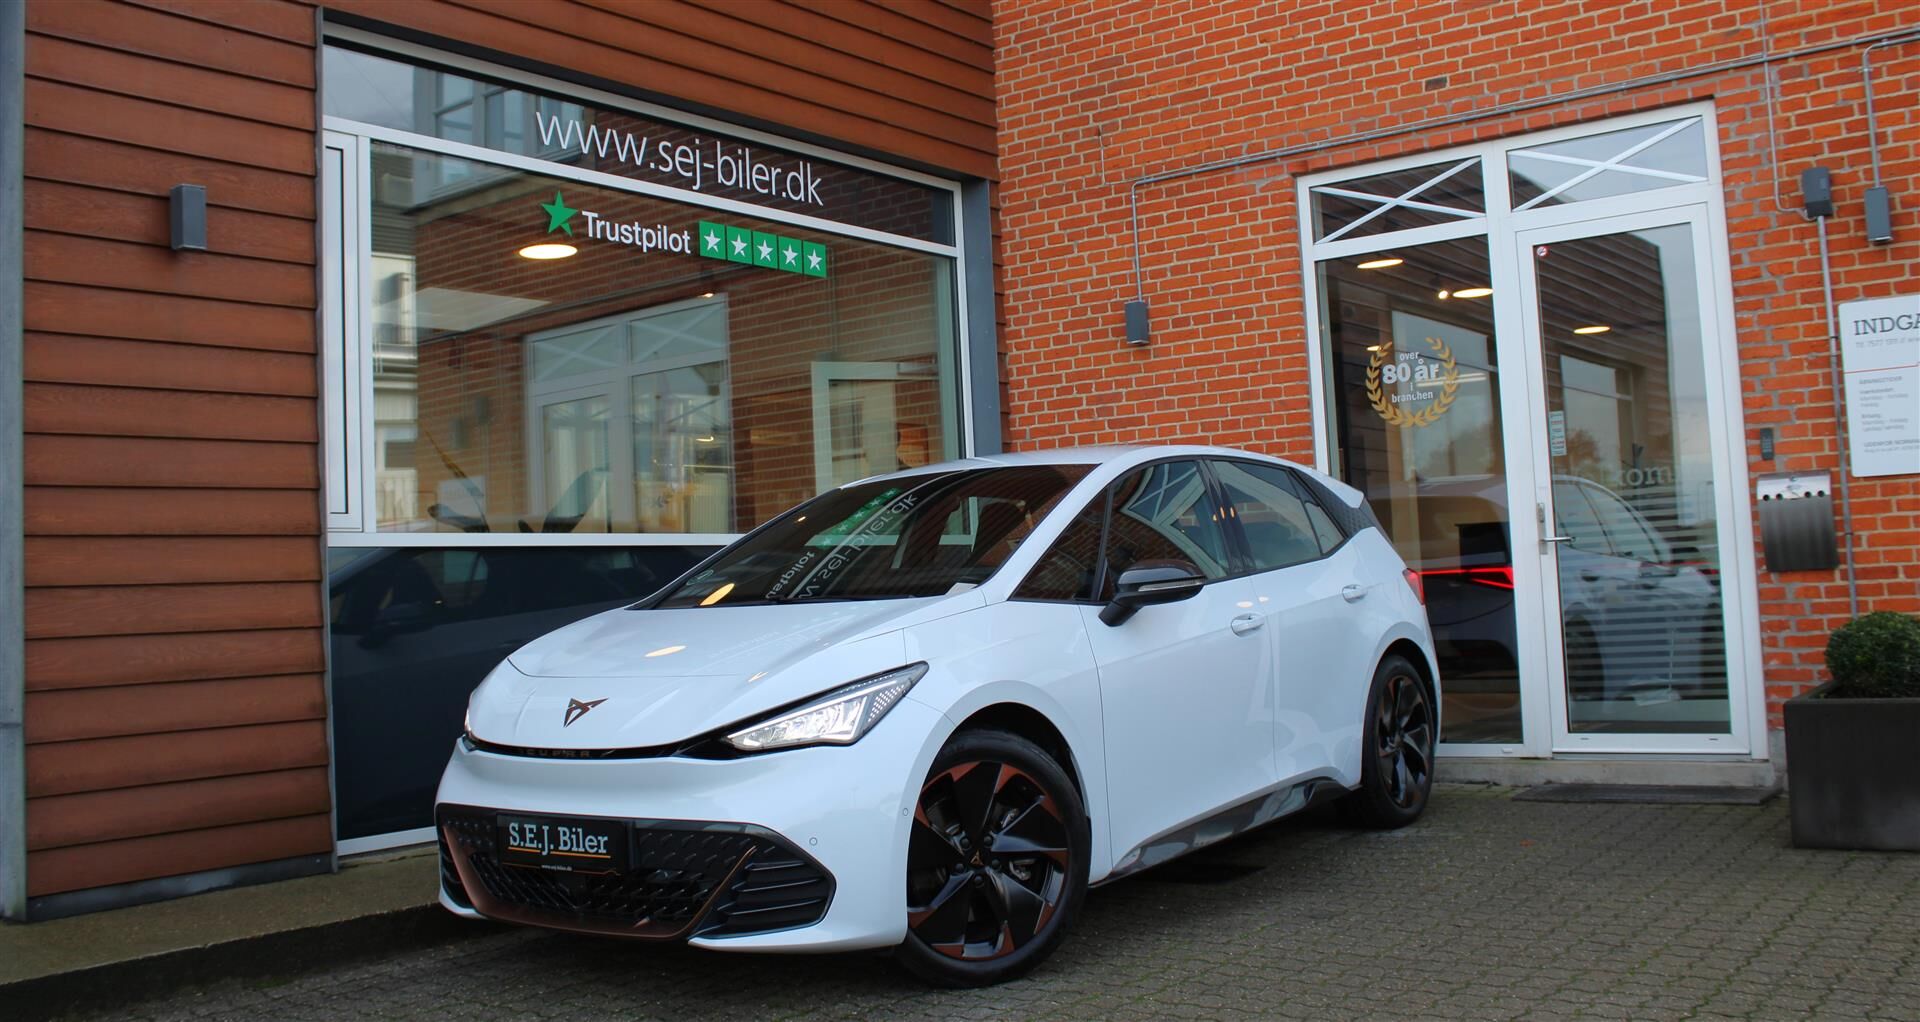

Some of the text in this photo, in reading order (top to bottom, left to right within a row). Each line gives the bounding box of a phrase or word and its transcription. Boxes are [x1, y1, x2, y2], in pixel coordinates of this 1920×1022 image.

[535, 111, 824, 206] www.sej-biler.dk
[581, 210, 691, 254] Trustpilot
[1382, 358, 1440, 384] 80 år
[1400, 351, 1420, 361] over
[1391, 391, 1434, 403] branchen
[508, 822, 608, 856] S.E.J. Biler
